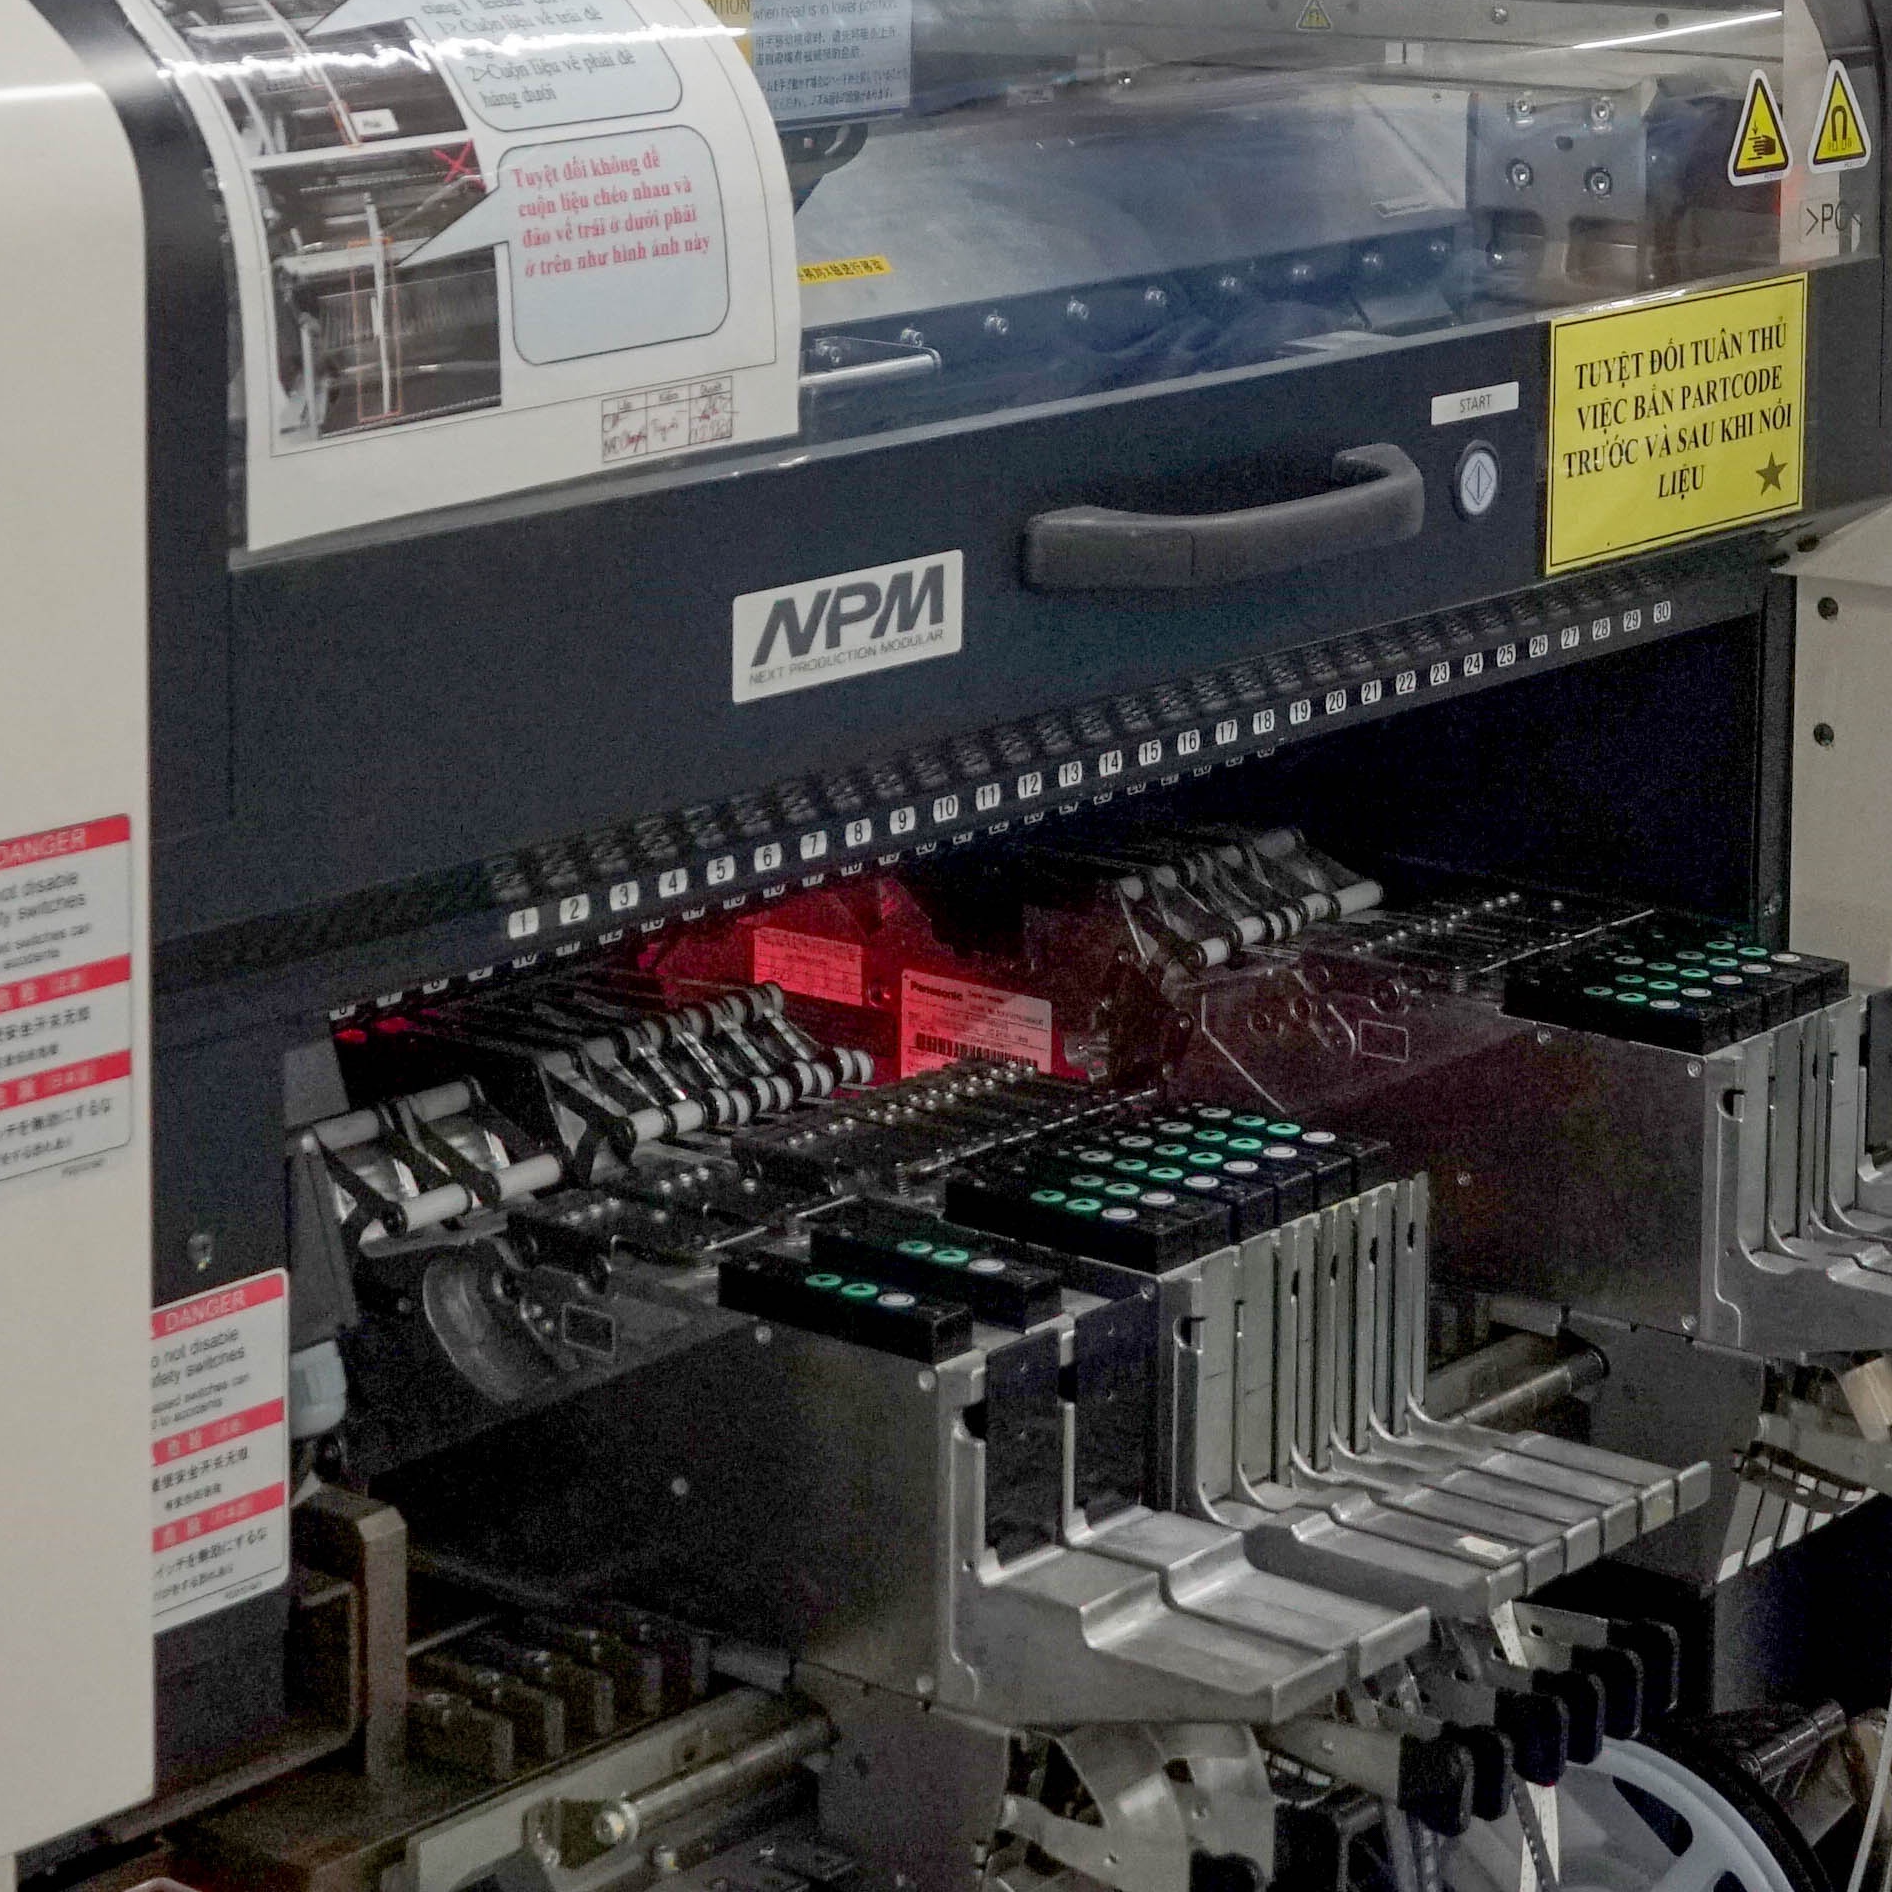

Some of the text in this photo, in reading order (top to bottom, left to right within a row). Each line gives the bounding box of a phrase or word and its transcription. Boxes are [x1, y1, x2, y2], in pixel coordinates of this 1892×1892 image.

[512, 162, 560, 189] Tuyệt
[563, 155, 588, 179] đối
[591, 151, 641, 177] không
[518, 196, 557, 220] cuộn
[560, 191, 589, 213] liệu
[592, 185, 629, 207] chéo
[632, 179, 671, 201] nhau
[576, 217, 606, 240] trái
[539, 253, 572, 276] trên
[1575, 315, 1788, 391] TUYỆT ĐỐI TUÂN THỦ
[1459, 393, 1493, 413] START
[1577, 396, 1628, 435] VIỆC
[1680, 364, 1784, 411] PARTCODE
[1563, 396, 1793, 479] TRƯỚC VÀ SAU KHI NỐI
[1657, 464, 1706, 501] LIỆU
[751, 564, 944, 667] NPM
[749, 628, 944, 685] NEXT PRODUCTION MODULAR
[519, 603, 1671, 933] 1 2 3 4 5 6 7 8 9 10 11 12 13 14 15 16 17 18 19 20 21 22 23 24 25 26 27 28 29 30
[21, 871, 79, 898] disable
[17, 892, 87, 921] switches
[164, 1288, 248, 1331] DANGER
[163, 1327, 240, 1363] not disable
[185, 1345, 246, 1378] switches
